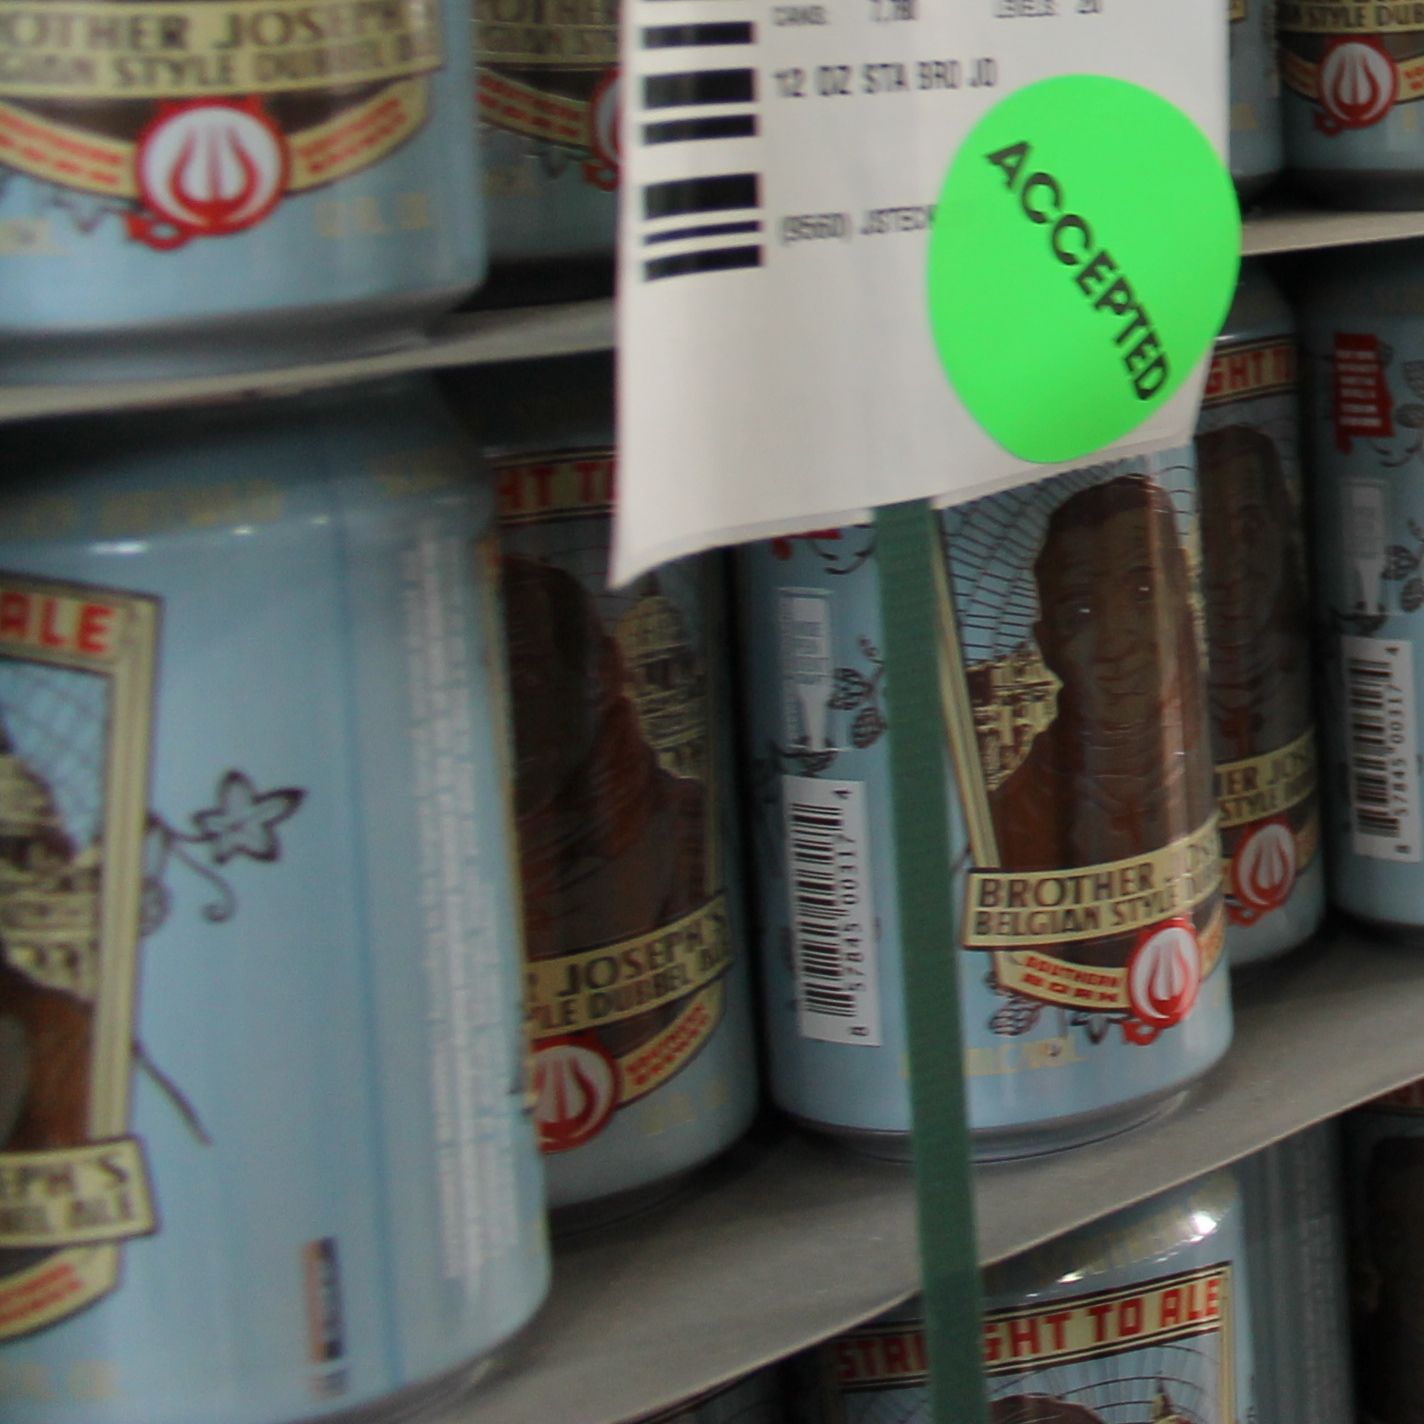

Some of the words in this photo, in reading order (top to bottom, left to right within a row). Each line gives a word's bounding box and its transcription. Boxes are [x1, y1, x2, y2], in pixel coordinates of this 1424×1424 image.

[860, 62, 910, 94] STA
[982, 140, 1172, 401] ACCEPTED
[0, 591, 116, 654] ALE
[976, 905, 1100, 937] BELGIAN
[1112, 885, 1178, 927] STYLE
[980, 862, 1155, 909] BROTHER
[837, 1312, 1073, 1377] STRGHT
[1087, 1297, 1145, 1343] TO
[1160, 1278, 1221, 1330] ALE
